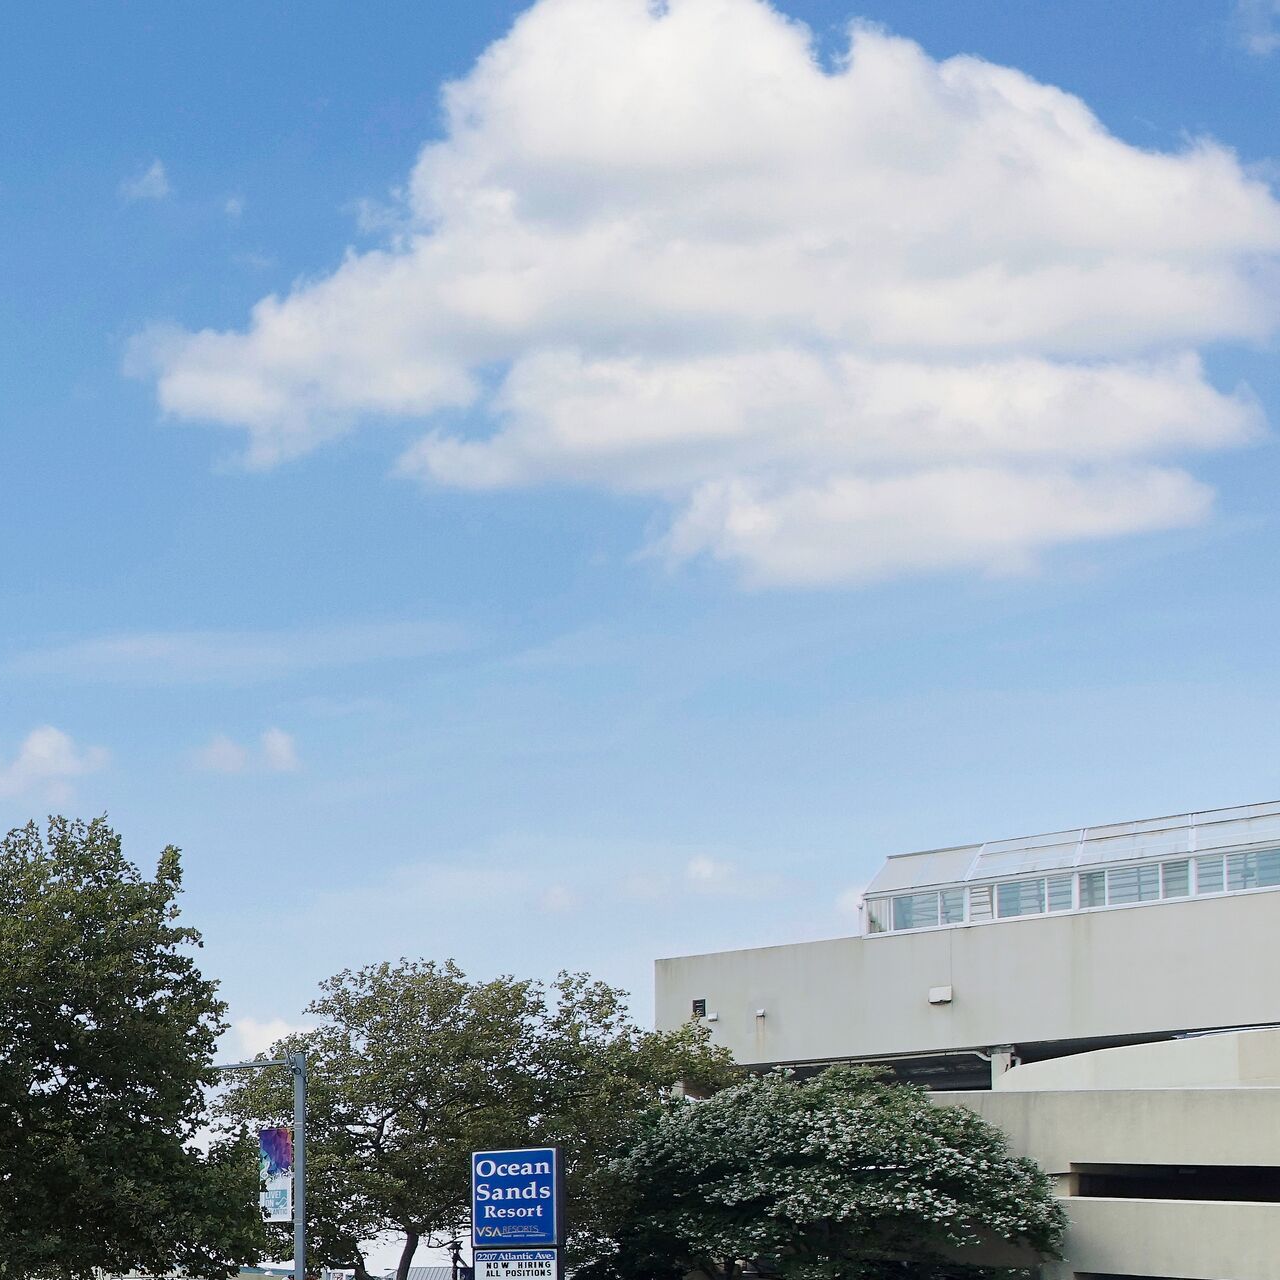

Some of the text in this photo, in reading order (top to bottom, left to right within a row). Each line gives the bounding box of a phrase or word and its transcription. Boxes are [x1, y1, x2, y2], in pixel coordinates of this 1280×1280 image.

[476, 1160, 551, 1177] Ocean
[476, 1181, 551, 1201] Sands
[484, 1204, 543, 1219] Resort
[476, 1225, 539, 1237] VSA RESORTS
[498, 1252, 533, 1260] Atlantic
[534, 1252, 554, 1260] Ave.
[518, 1261, 551, 1269] HIRING
[506, 1269, 552, 1277] POSITIONS
